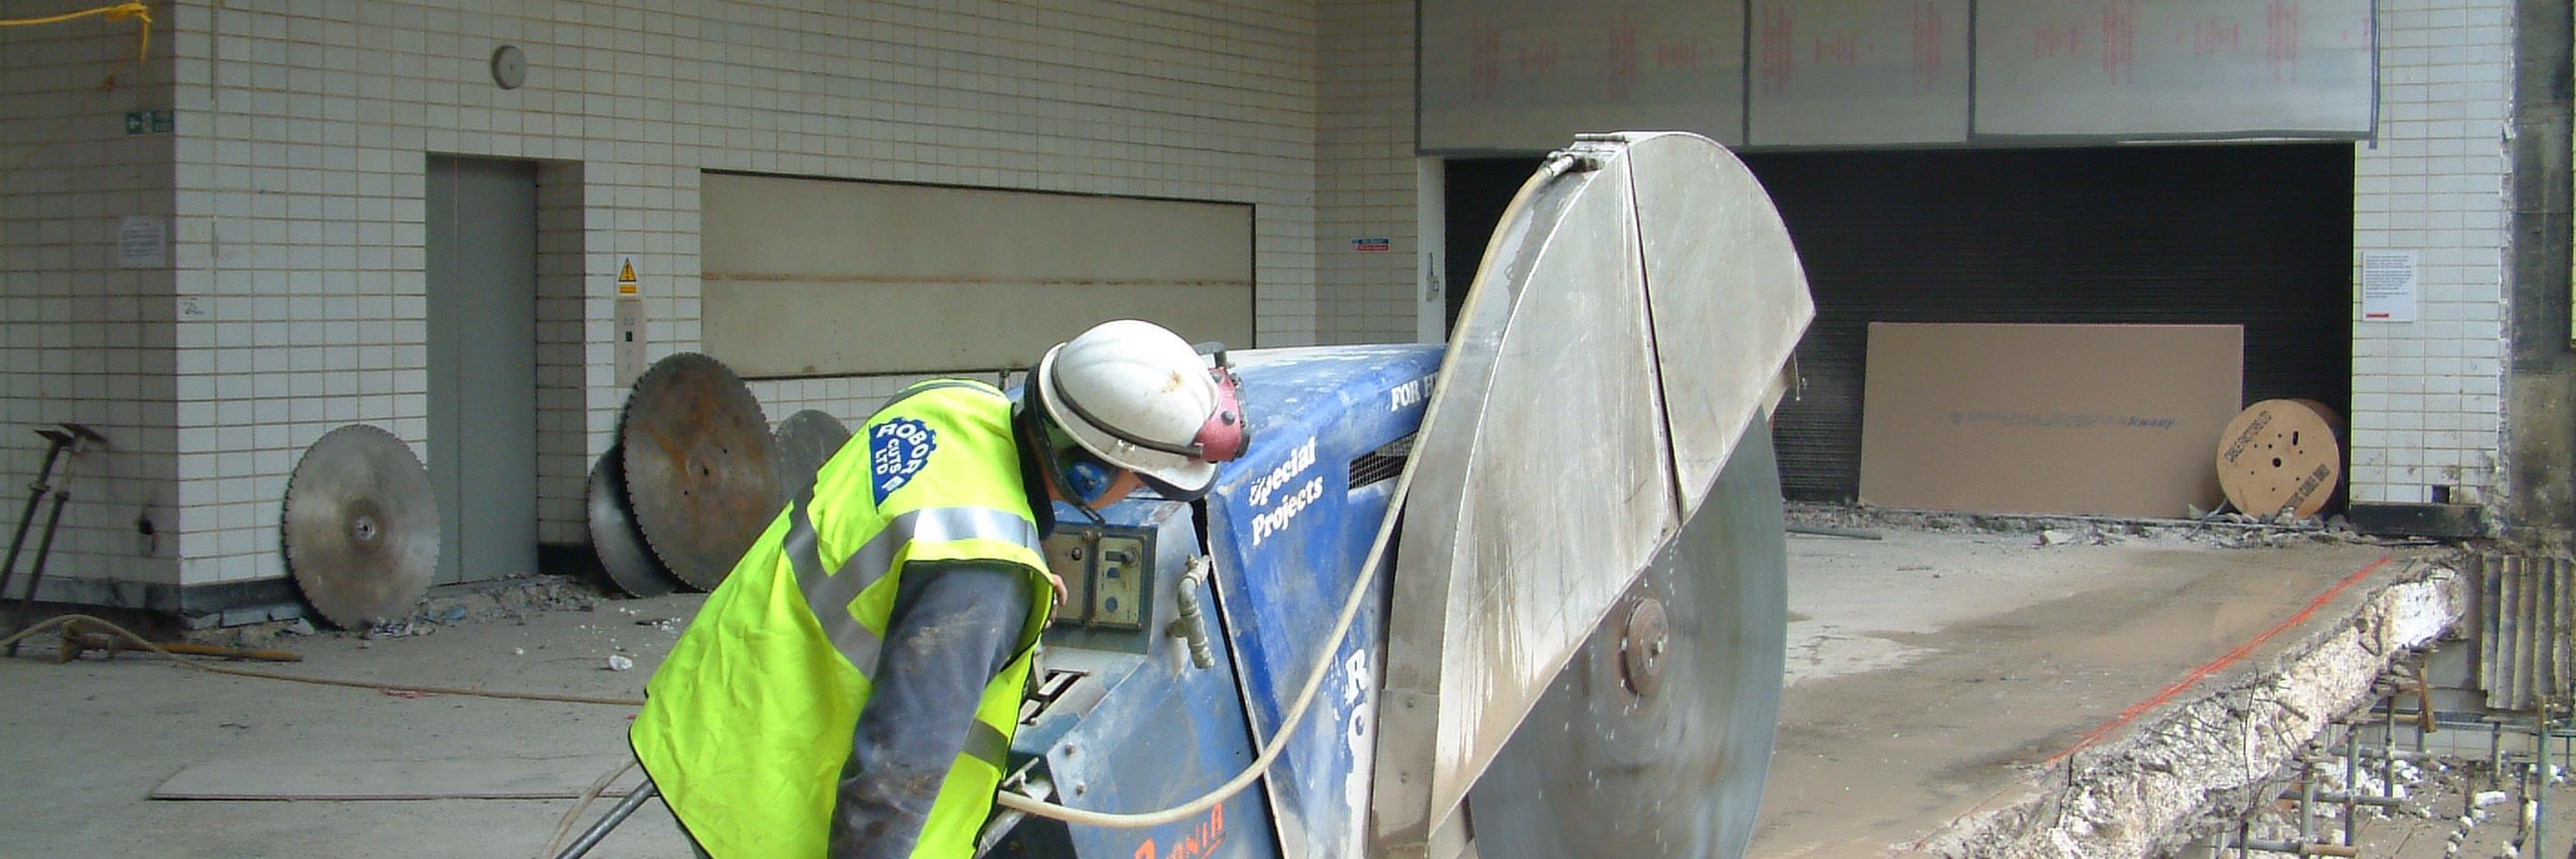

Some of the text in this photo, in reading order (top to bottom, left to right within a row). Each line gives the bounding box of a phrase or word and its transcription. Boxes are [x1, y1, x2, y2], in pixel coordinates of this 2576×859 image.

[1391, 379, 1420, 411] FOR
[875, 449, 889, 475] LTD
[887, 439, 902, 474] CUTS
[1252, 476, 1323, 547] Projects
